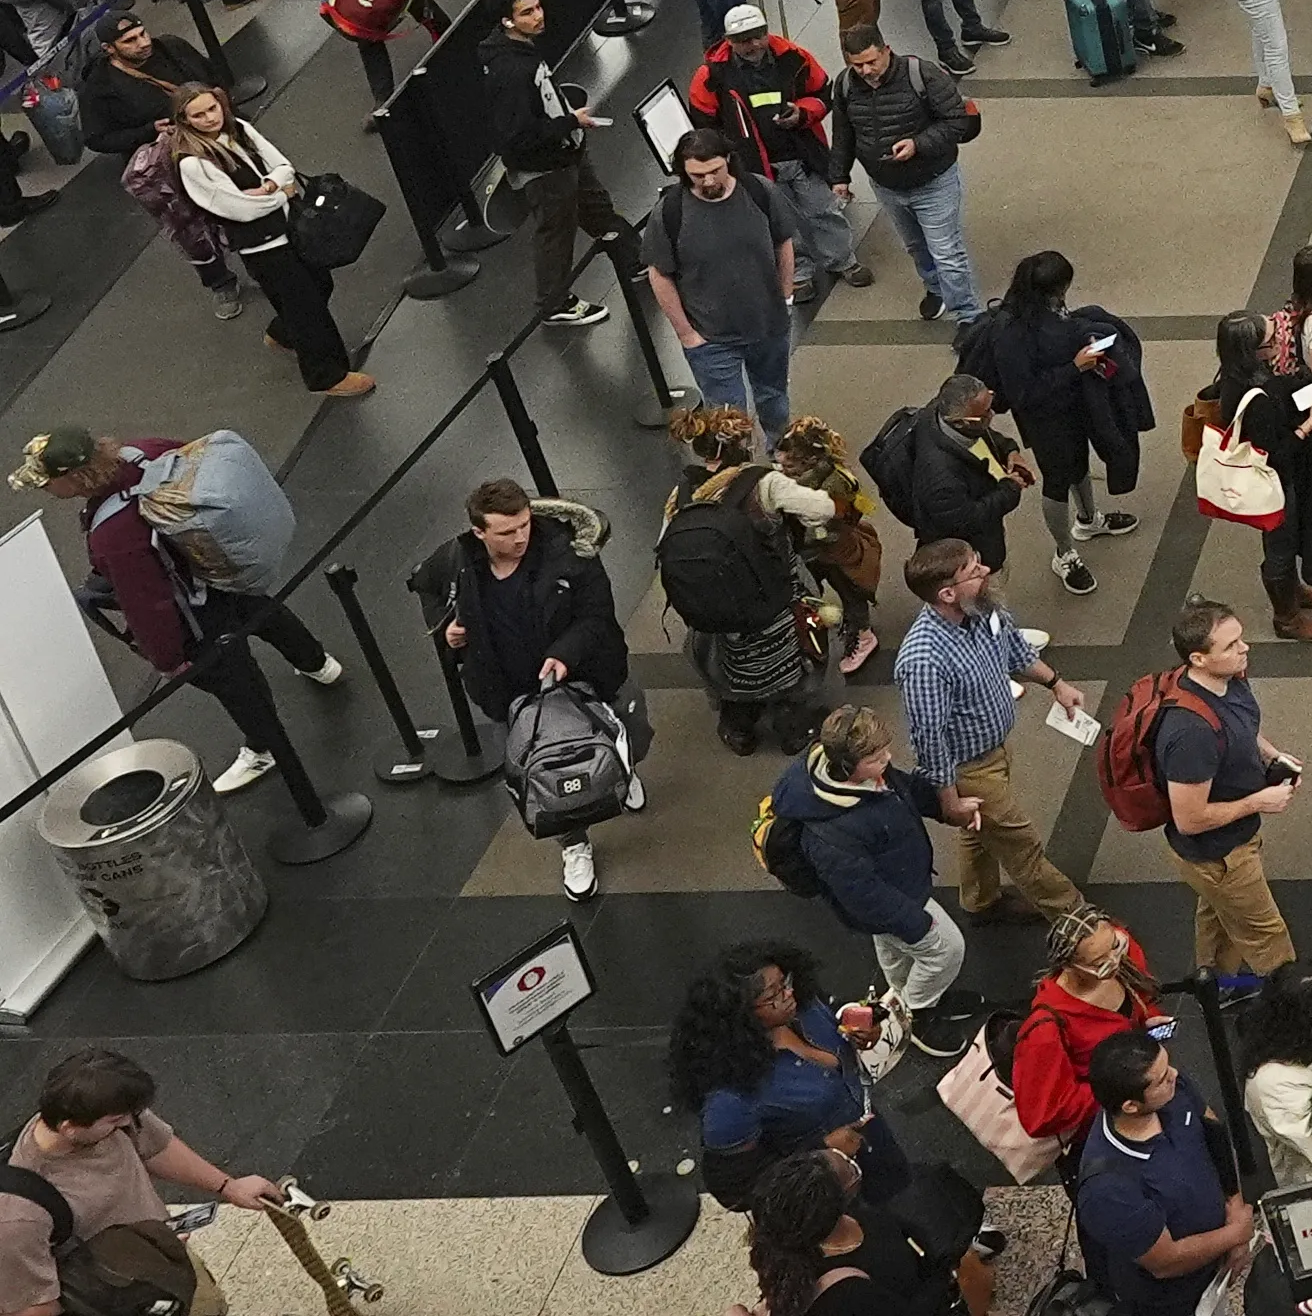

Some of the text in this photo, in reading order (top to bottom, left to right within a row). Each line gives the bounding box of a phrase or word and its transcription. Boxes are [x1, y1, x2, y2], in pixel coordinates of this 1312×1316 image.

[563, 778, 581, 793] 88
[78, 851, 142, 871] BOTTLES
[101, 864, 143, 882] CANS
